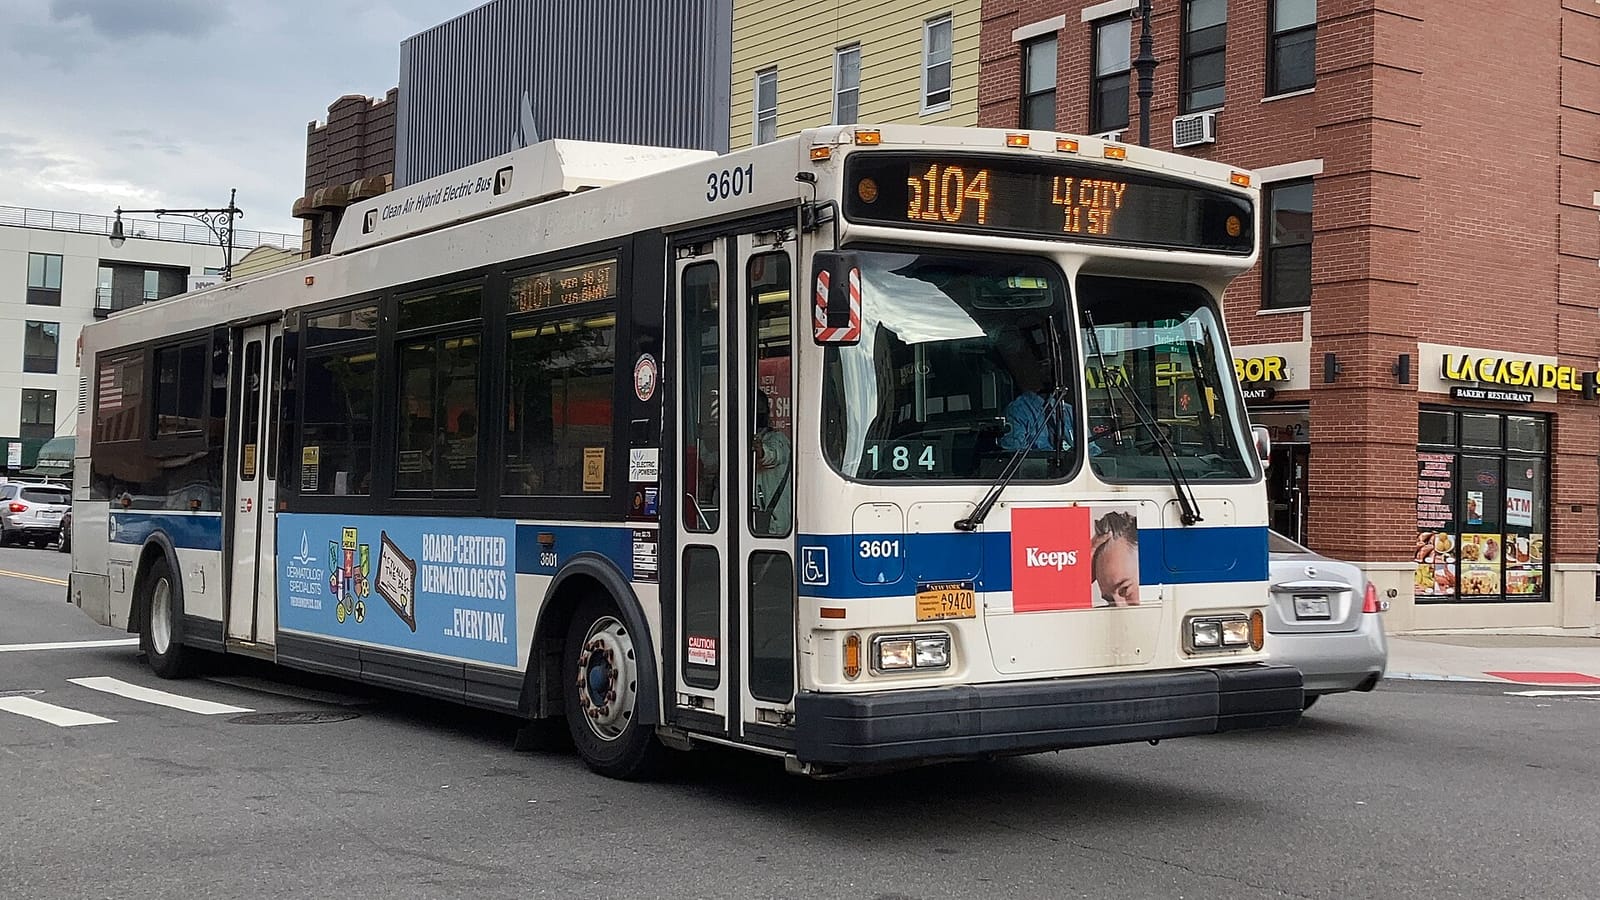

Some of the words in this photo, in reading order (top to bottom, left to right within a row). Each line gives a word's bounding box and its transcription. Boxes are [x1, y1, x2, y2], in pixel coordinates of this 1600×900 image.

[707, 163, 753, 202] 3601
[1052, 176, 1073, 205] LI
[1080, 179, 1126, 209] CITY
[382, 203, 402, 220] Clean
[402, 197, 415, 215] Air
[415, 188, 442, 213] Hybrid
[442, 181, 474, 202] Electric
[474, 176, 492, 194] Bus
[1063, 206, 1079, 233] 11
[1087, 209, 1111, 235] ST
[597, 266, 610, 284] ST
[1446, 353, 1475, 381] LA
[1479, 358, 1538, 387] CASA
[1542, 364, 1583, 391] DEL
[1456, 389, 1486, 399] BAKERY
[1487, 391, 1532, 402] RESTAURANT
[867, 445, 935, 470] 184
[1507, 498, 1530, 513] ATM
[422, 533, 506, 567] BOARD-CERTIFIED
[540, 552, 558, 568] 3601
[859, 540, 899, 558] 3601
[1026, 547, 1078, 572] Keeps
[286, 566, 324, 581] DERMATOLOGY
[421, 567, 507, 601] DERMATOLOGISTS
[289, 580, 322, 595] SPECIALISTS
[485, 612, 508, 644] DAY.
[689, 637, 716, 649] CAUTION
